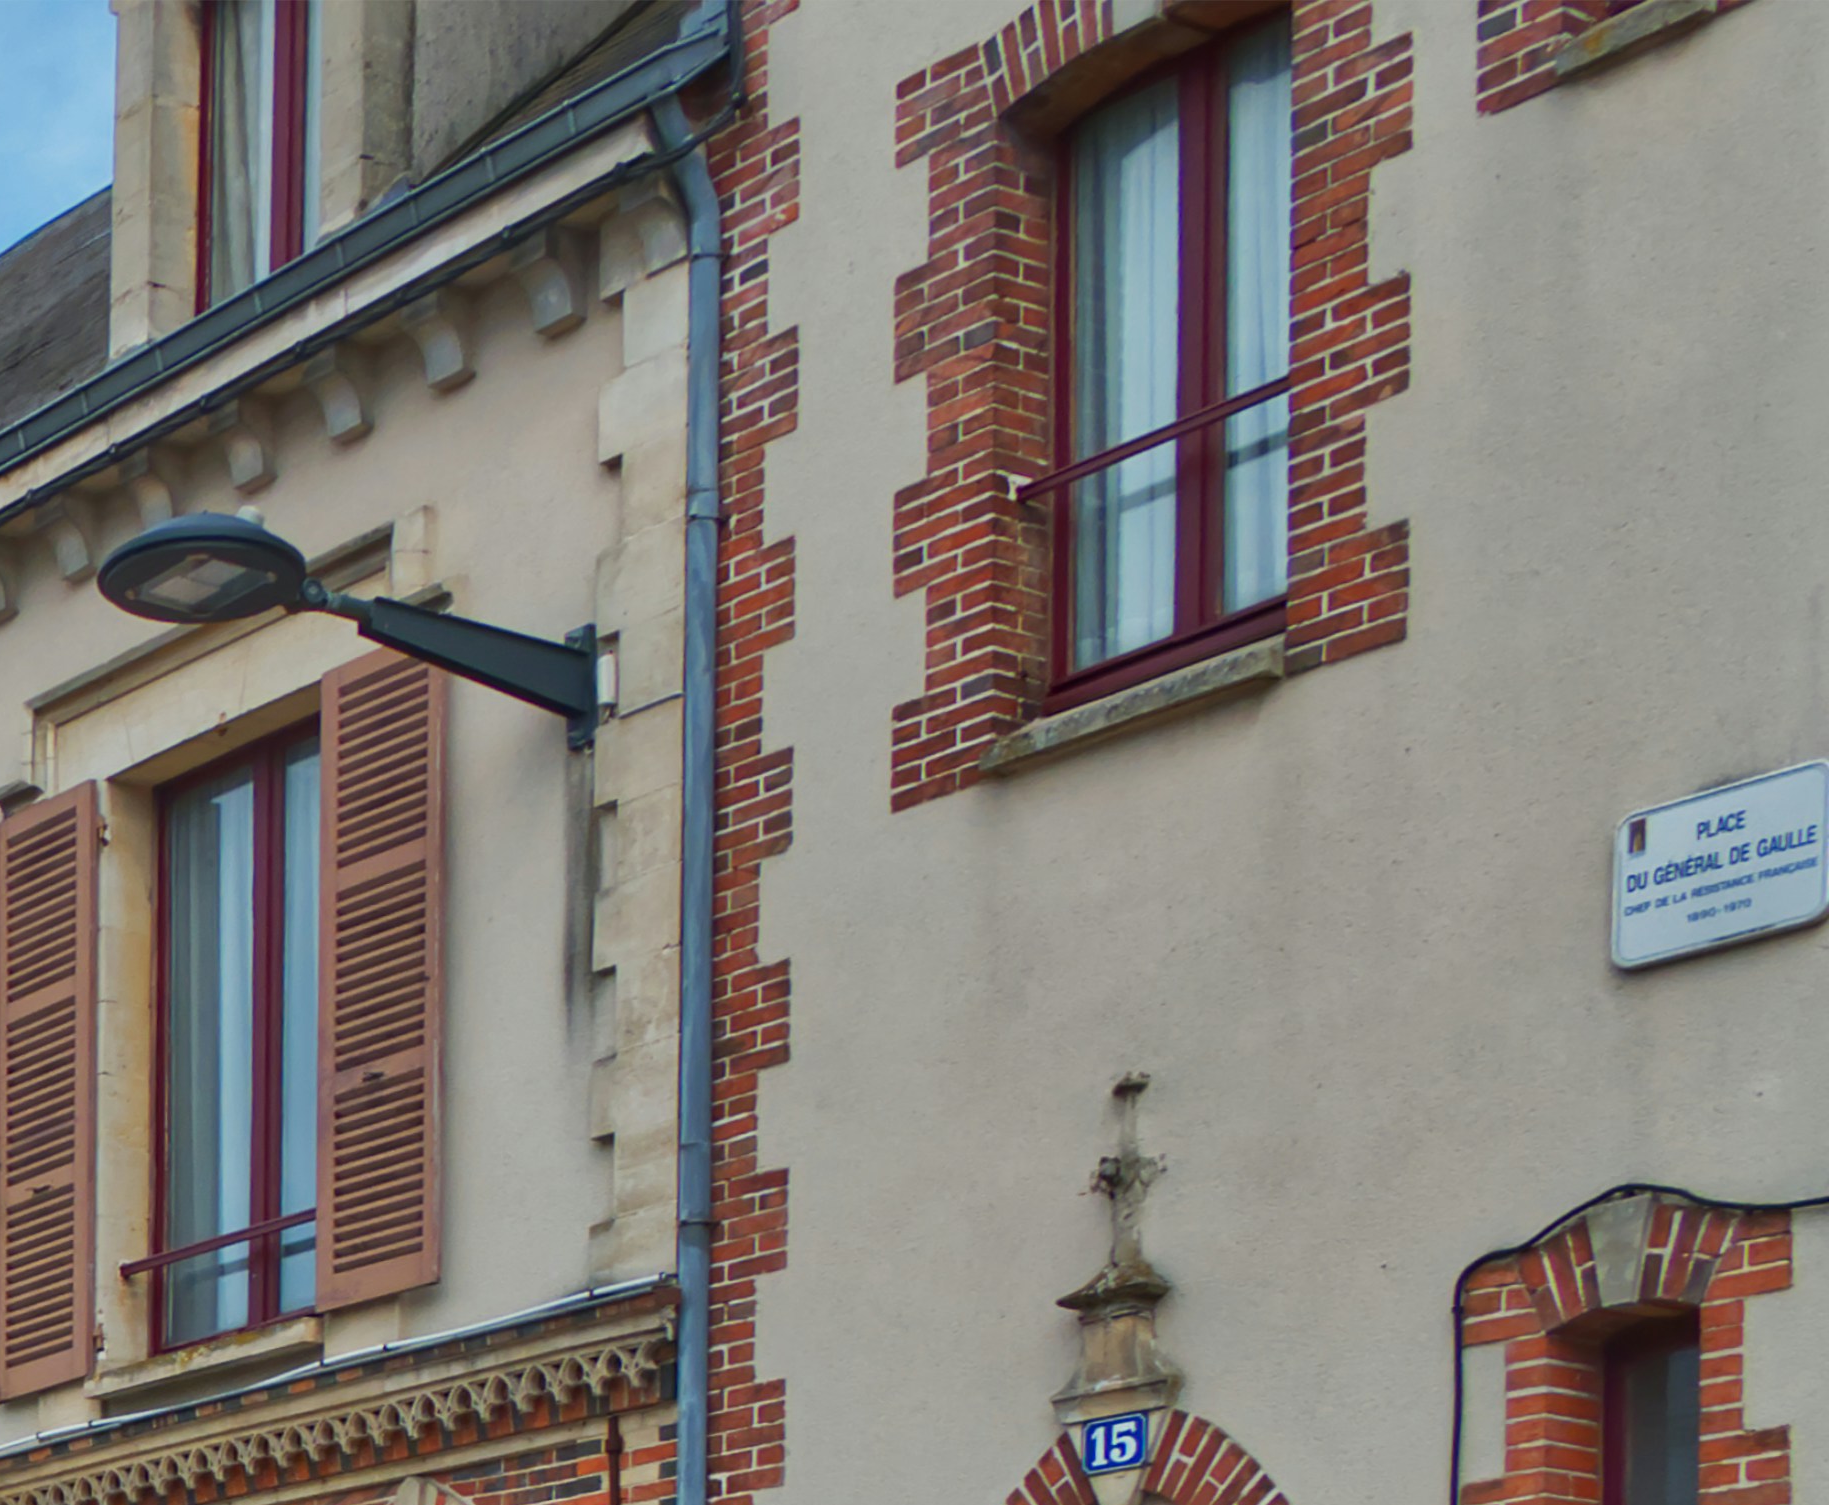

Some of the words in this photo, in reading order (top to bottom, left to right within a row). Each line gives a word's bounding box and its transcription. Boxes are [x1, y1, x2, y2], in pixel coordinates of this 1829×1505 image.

[1696, 810, 1747, 840] PLACE
[1626, 873, 1649, 893] DU
[1653, 850, 1724, 886] GÉNÉRAL
[1728, 842, 1752, 866] DE
[1756, 825, 1819, 858] GAULLE
[1624, 900, 1652, 917] CHEF
[1655, 896, 1670, 909] DE
[1672, 891, 1688, 904] LA
[1091, 1420, 1137, 1467] 15
